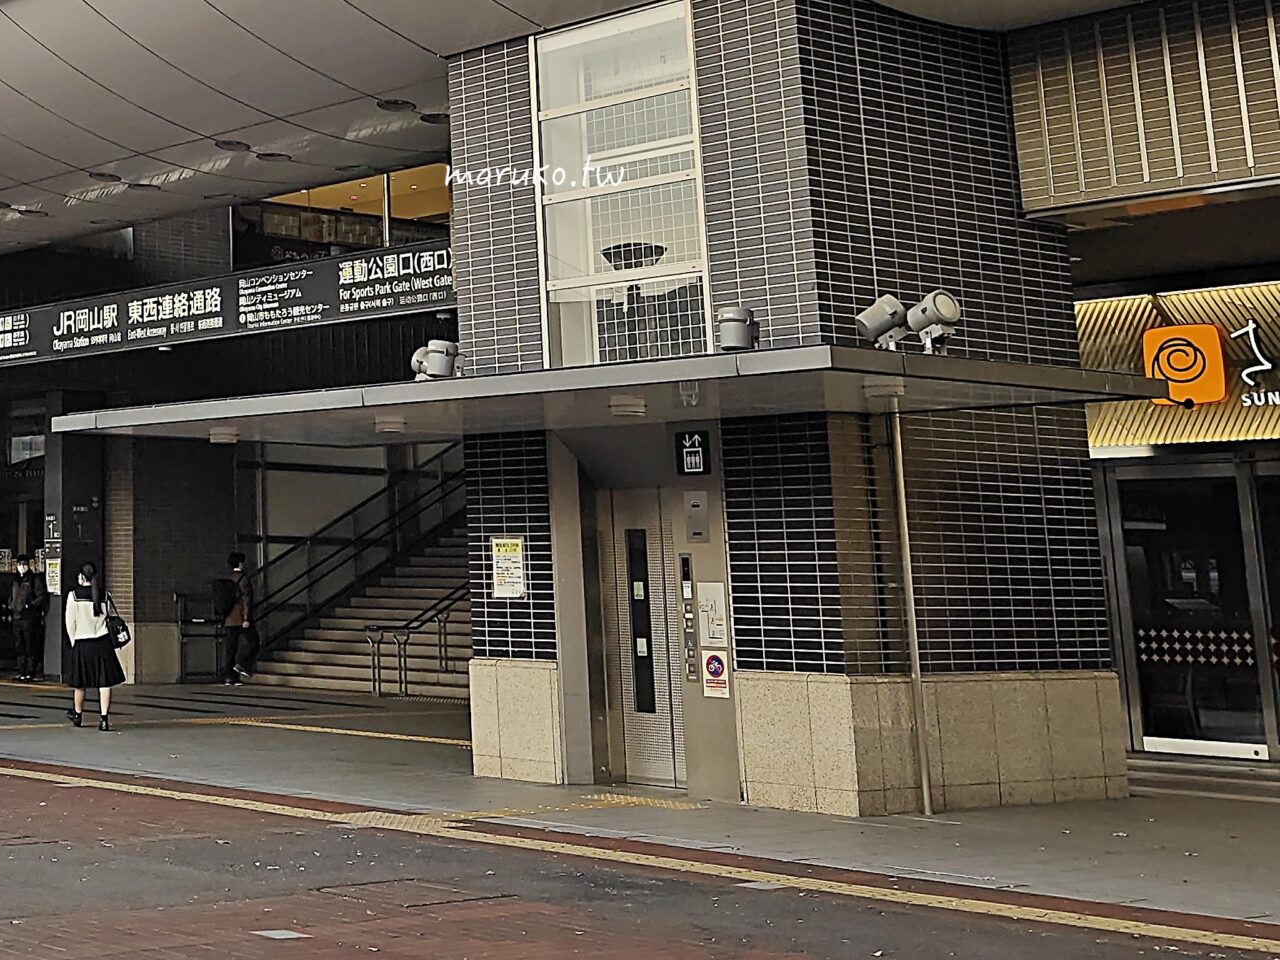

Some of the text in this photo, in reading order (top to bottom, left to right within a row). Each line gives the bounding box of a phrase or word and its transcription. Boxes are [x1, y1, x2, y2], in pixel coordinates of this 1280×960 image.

[338, 248, 453, 285] 運動公園口(西口)
[339, 288, 350, 300] For
[352, 284, 374, 301] Sports
[375, 281, 391, 295] Park
[392, 279, 410, 292] Gate
[411, 276, 433, 291] (West
[53, 304, 118, 336] JR岡山駅
[127, 287, 221, 324] 東西連絡通路
[73, 336, 89, 348] Station
